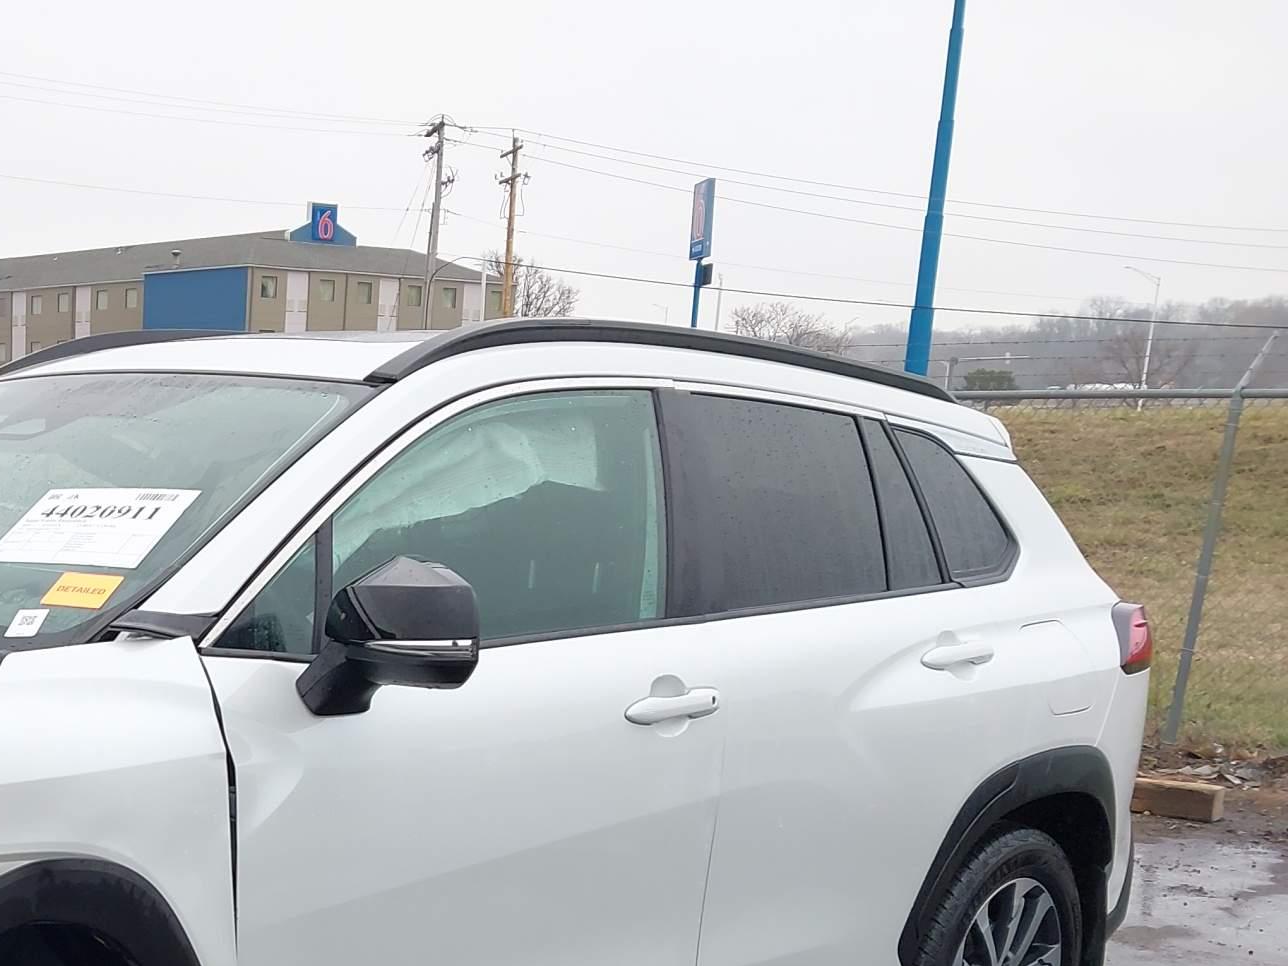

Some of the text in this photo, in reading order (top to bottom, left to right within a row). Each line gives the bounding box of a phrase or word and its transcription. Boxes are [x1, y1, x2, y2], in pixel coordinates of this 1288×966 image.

[319, 210, 334, 240] 6
[40, 504, 162, 520] 44020911
[56, 584, 107, 595] DETAILED
